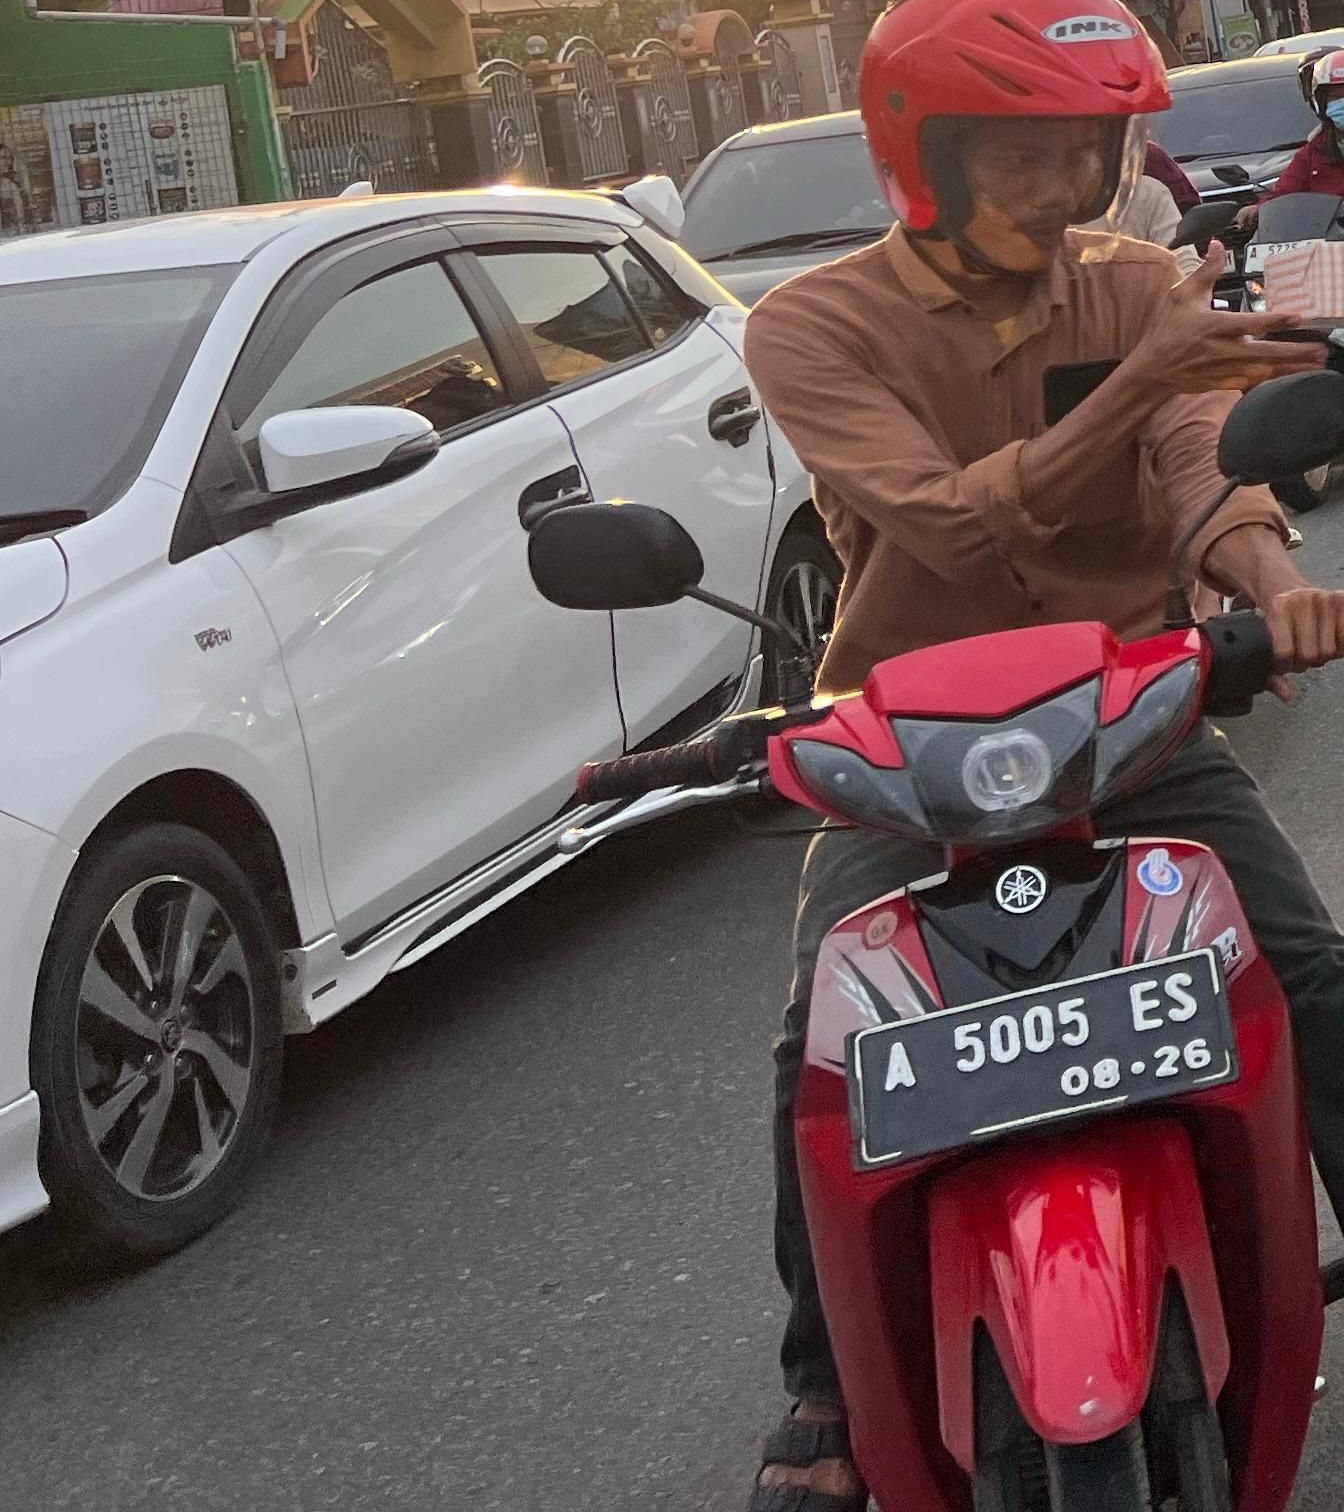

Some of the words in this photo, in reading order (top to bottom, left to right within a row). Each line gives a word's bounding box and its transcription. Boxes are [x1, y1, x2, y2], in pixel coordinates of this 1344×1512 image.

[1055, 20, 1122, 38] INK
[884, 1041, 917, 1092] A
[953, 997, 1091, 1073] 5005
[1129, 971, 1199, 1033] ES
